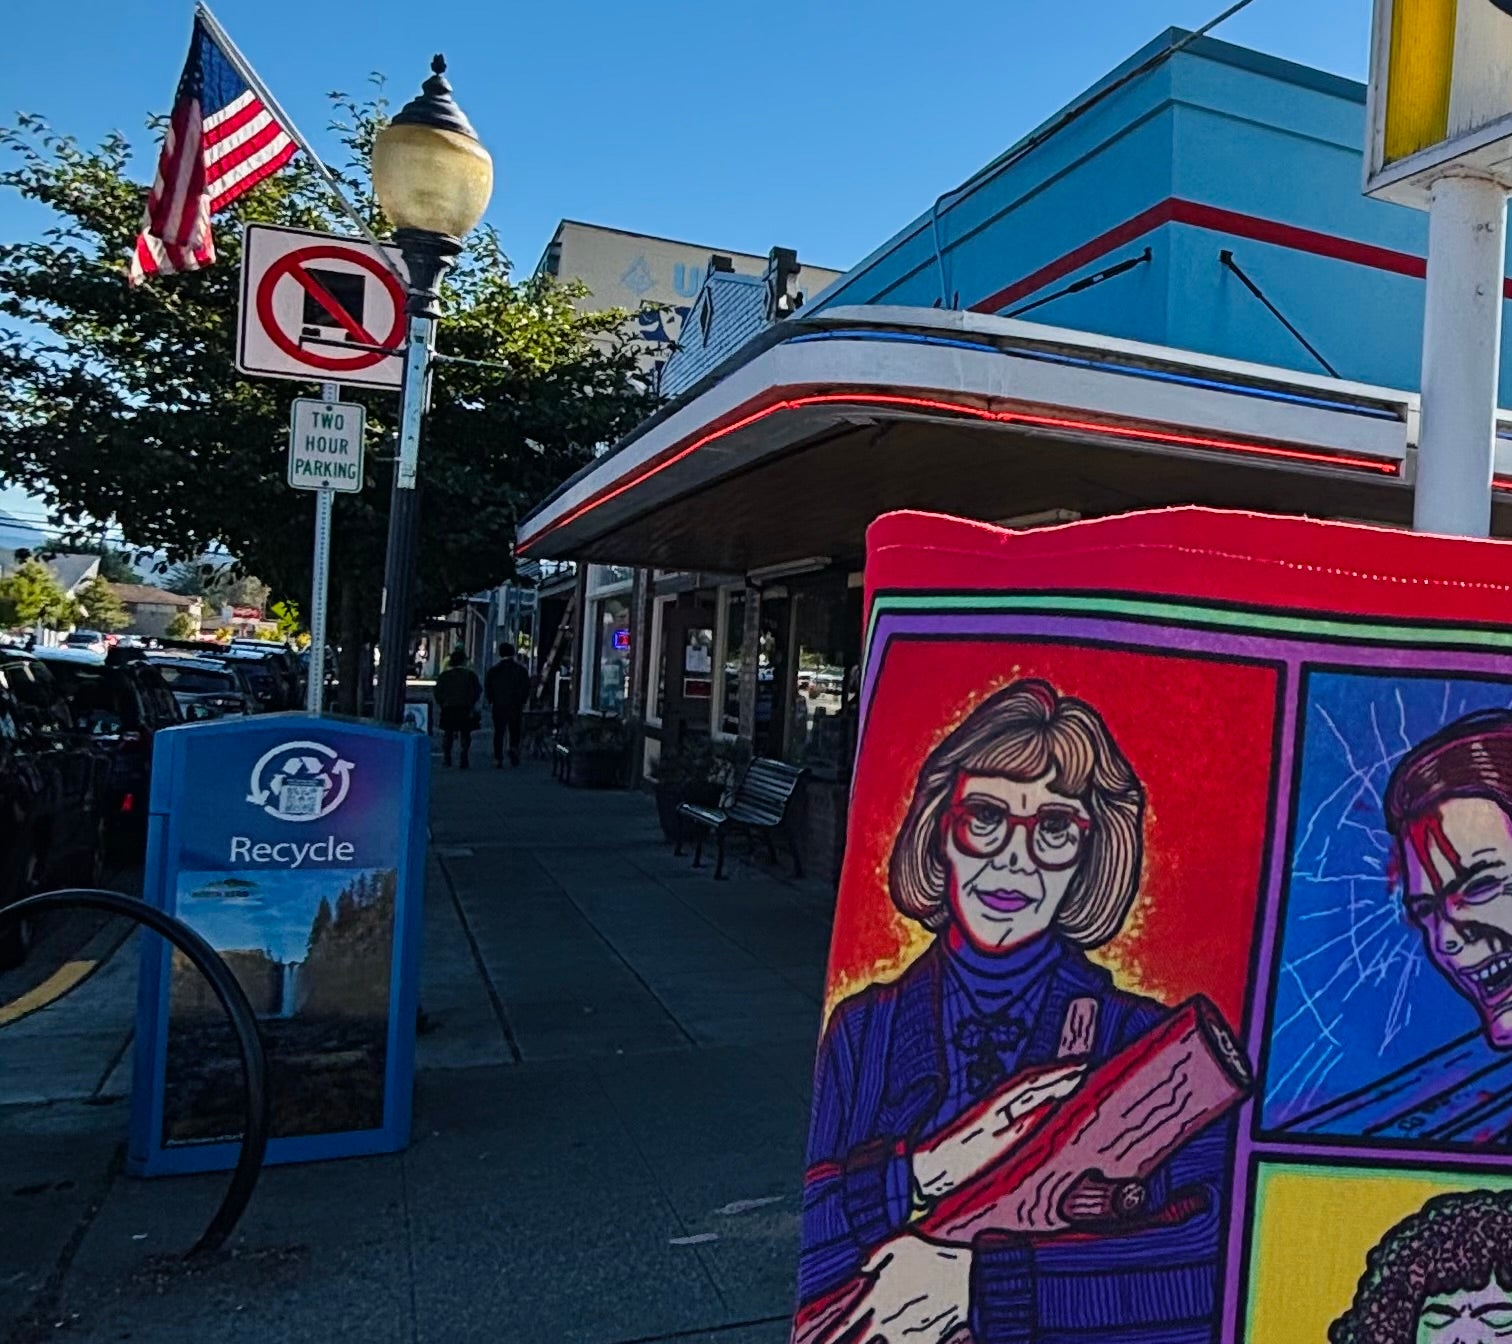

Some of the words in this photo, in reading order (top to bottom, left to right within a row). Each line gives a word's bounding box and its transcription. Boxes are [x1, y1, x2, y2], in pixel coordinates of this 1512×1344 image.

[312, 411, 344, 431] TWO
[306, 435, 349, 455] HOUR
[295, 458, 357, 480] PARKING
[229, 835, 355, 869] Recycle
